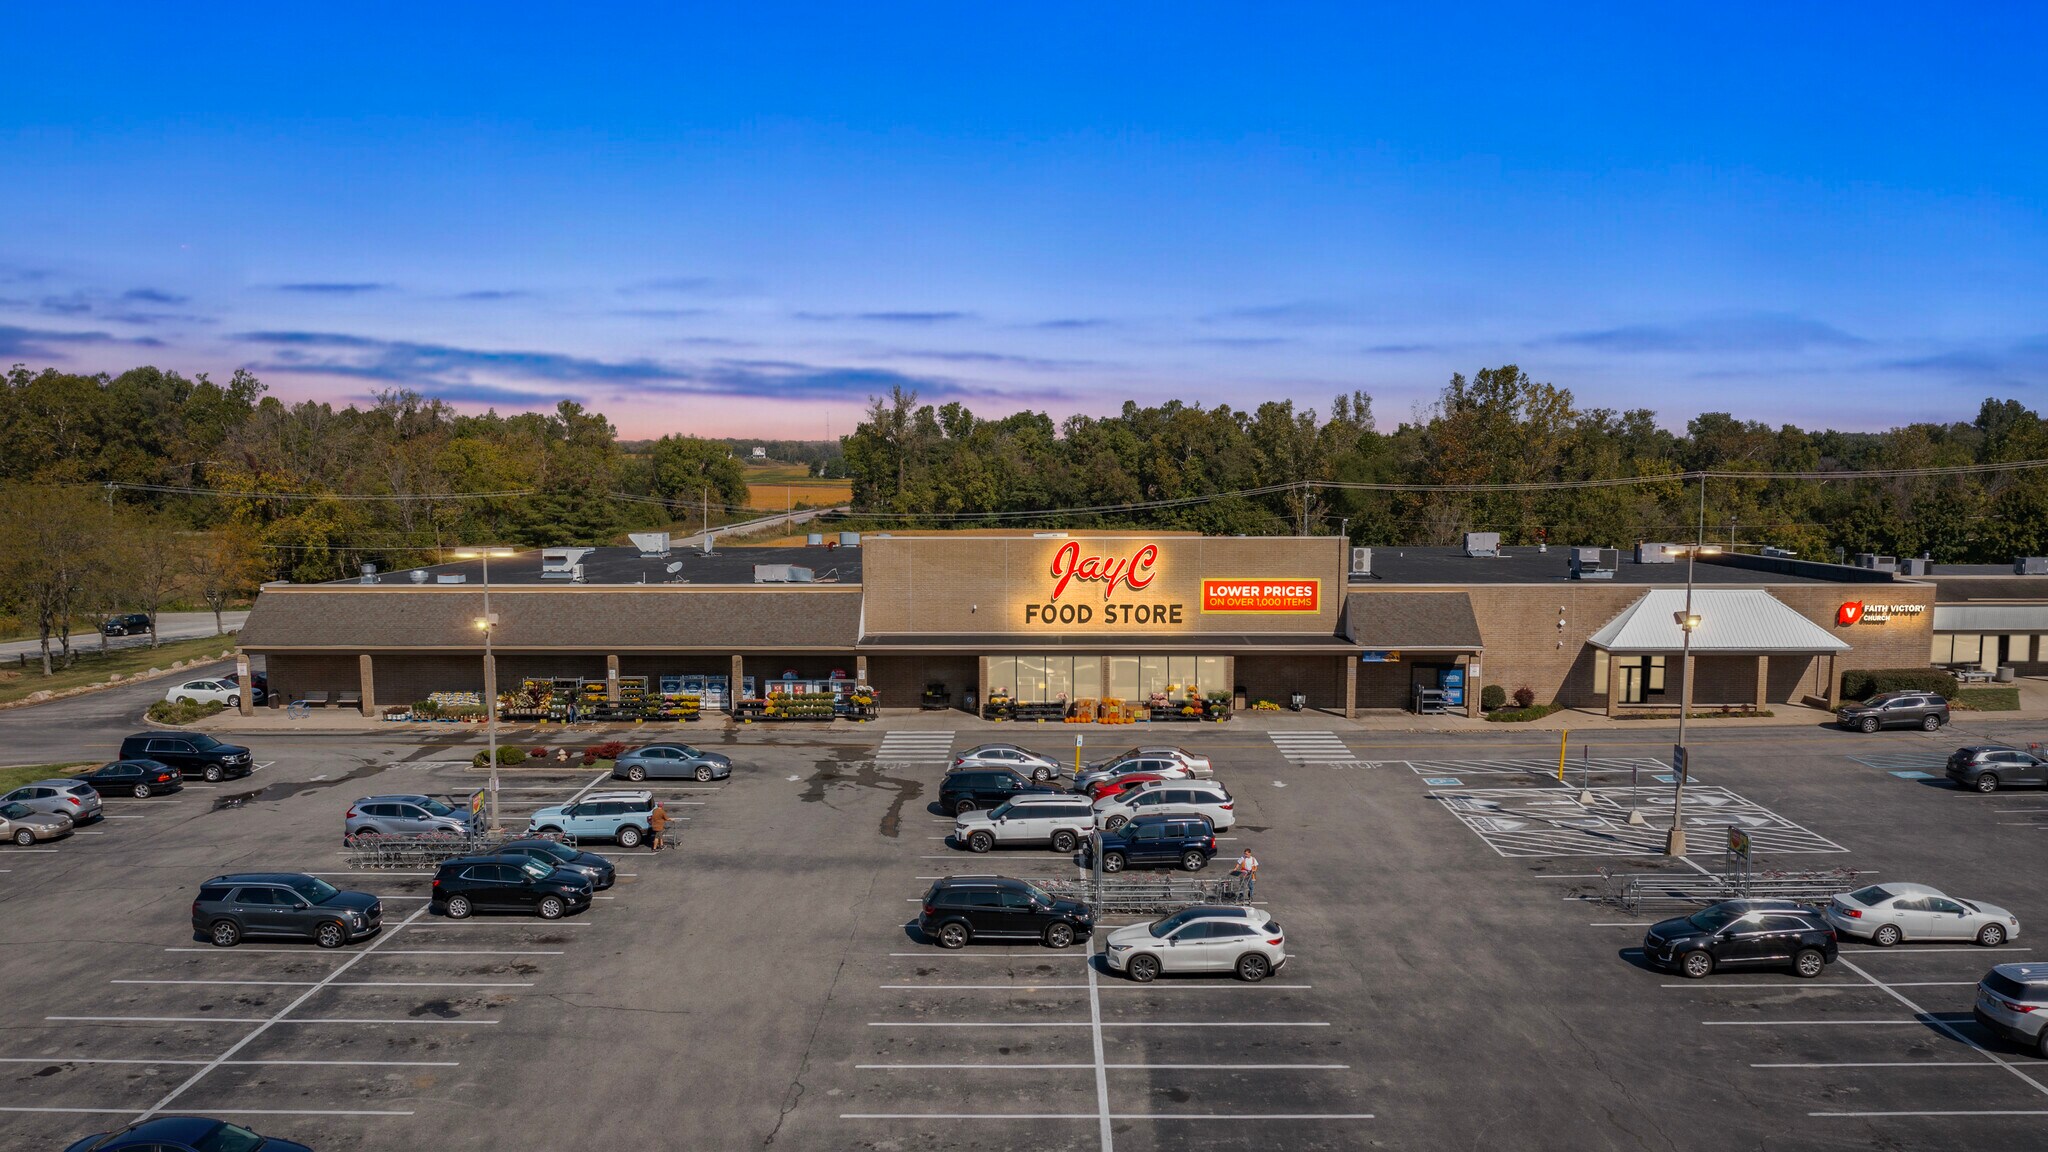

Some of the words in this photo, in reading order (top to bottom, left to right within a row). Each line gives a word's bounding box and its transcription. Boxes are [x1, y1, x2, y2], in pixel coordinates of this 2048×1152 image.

[1050, 540, 1159, 600] JayC
[1209, 586, 1259, 597] LOWER
[1263, 586, 1312, 597] PRICES
[1209, 598, 1225, 606] ON
[1226, 598, 1254, 606] OVER
[1256, 598, 1281, 607] 1,000
[1283, 598, 1312, 606] ITEMS
[1864, 604, 1889, 612] FAITH
[1890, 604, 1926, 612] VICTORY
[1025, 604, 1093, 624] FOOD
[1104, 604, 1183, 624] STORE
